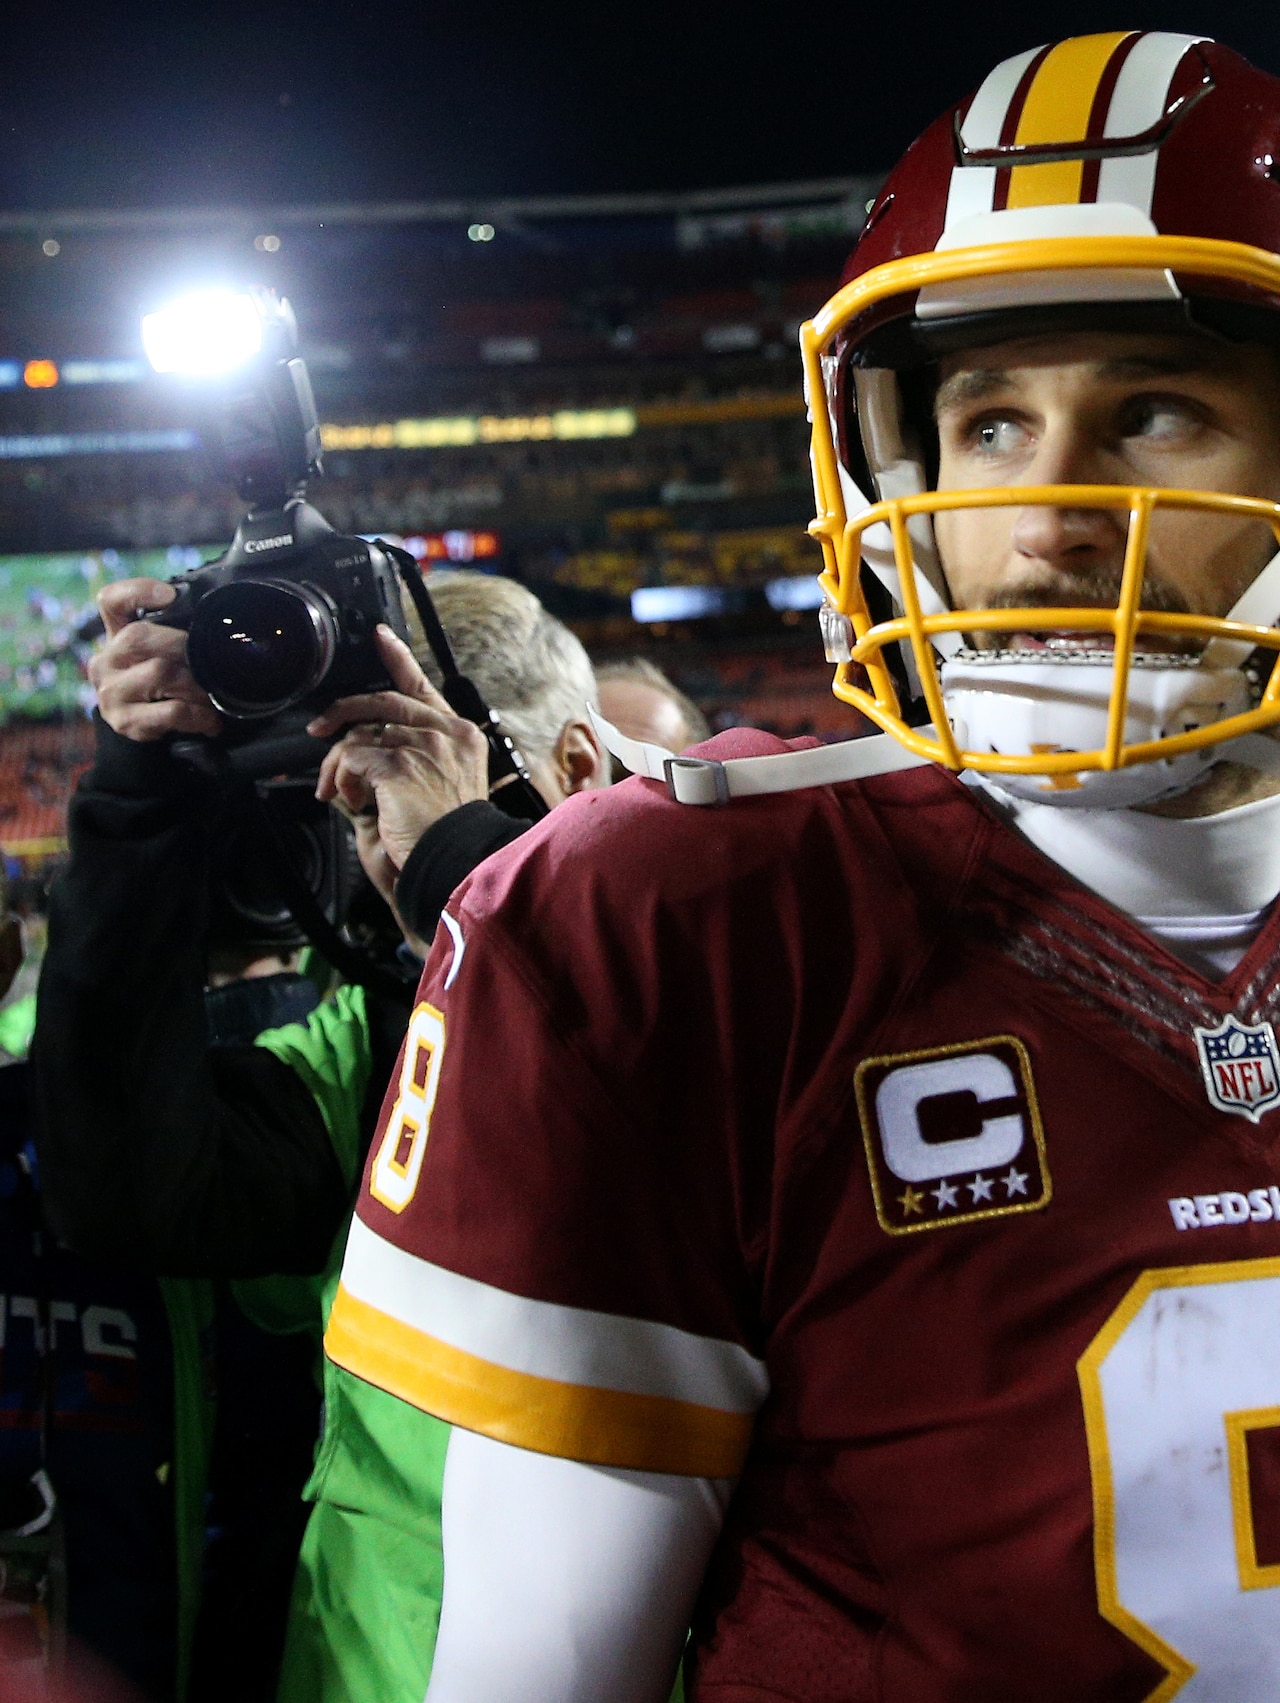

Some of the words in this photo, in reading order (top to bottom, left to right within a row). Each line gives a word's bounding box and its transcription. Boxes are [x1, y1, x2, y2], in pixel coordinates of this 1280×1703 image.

[244, 534, 293, 553] Canon
[370, 1001, 446, 1214] 8
[875, 1053, 1024, 1182] C
[1216, 1061, 1274, 1100] NFL
